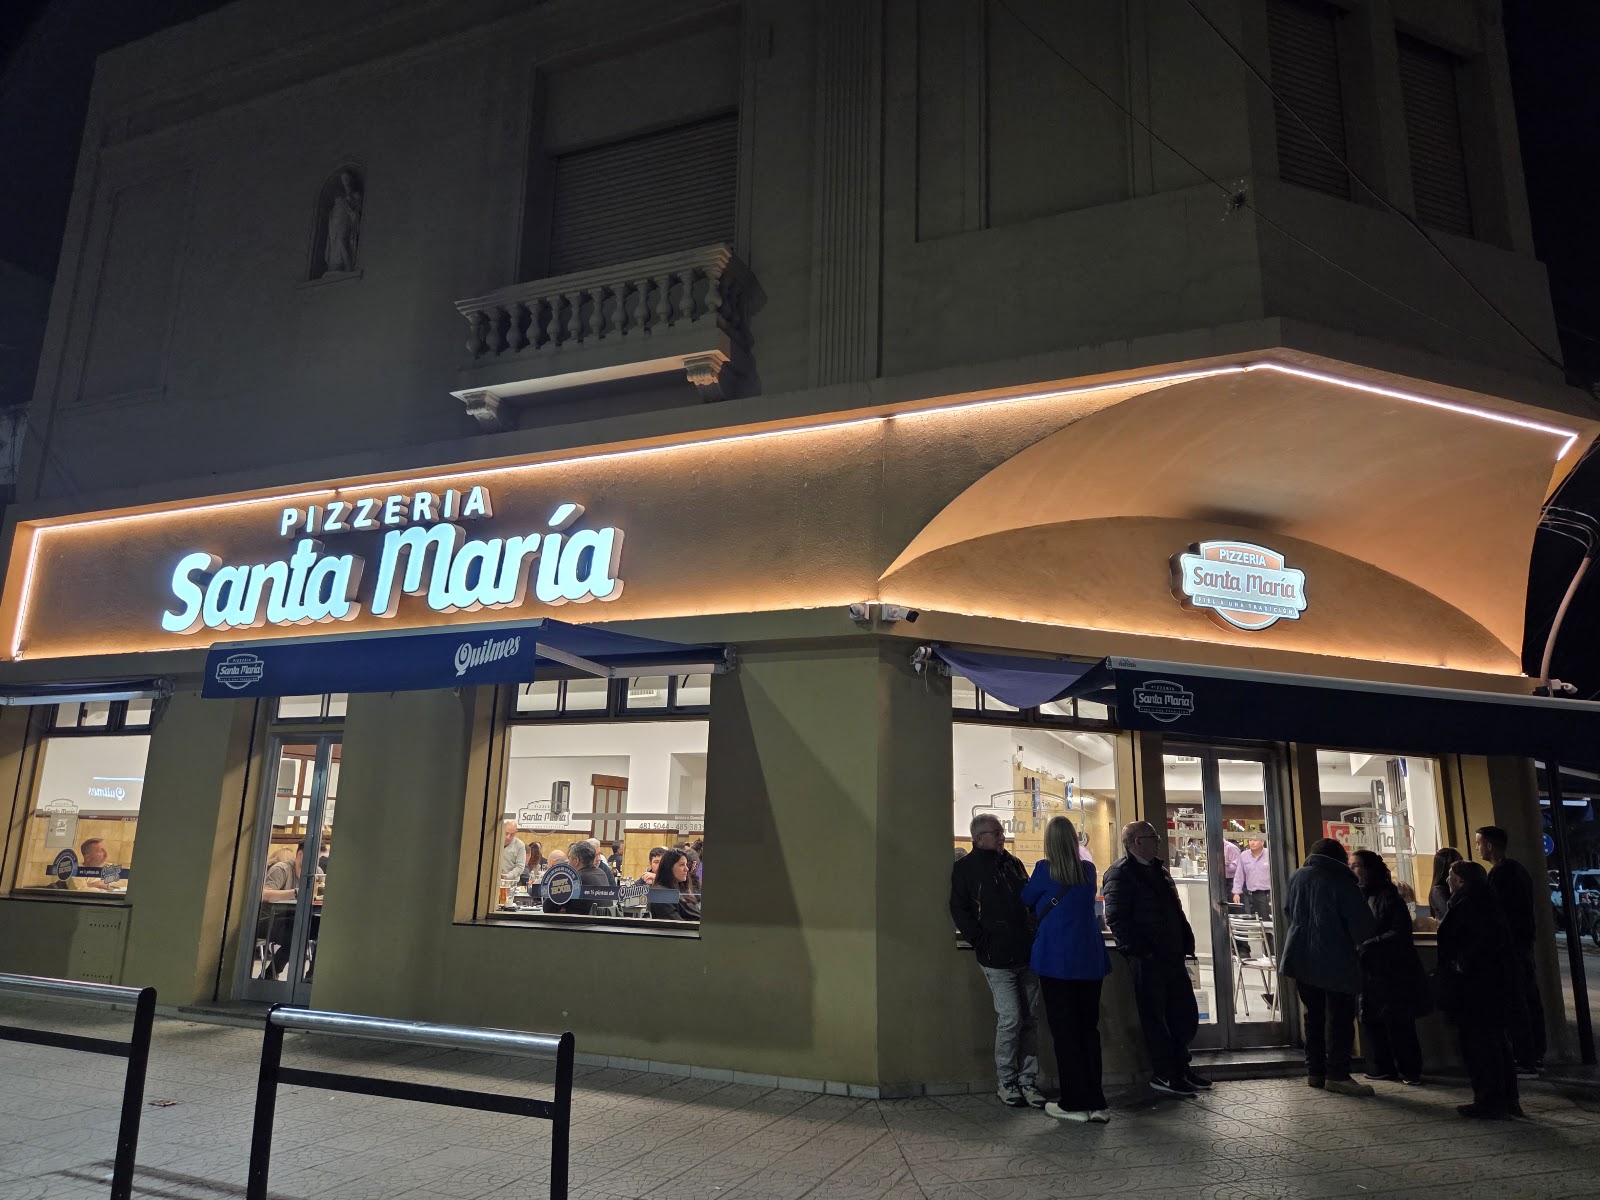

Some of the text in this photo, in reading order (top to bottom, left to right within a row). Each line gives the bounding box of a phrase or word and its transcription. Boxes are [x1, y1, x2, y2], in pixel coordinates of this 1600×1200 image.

[280, 485, 488, 537] PIZZERIA
[1219, 548, 1267, 567] PIZZERIA
[161, 503, 617, 633] Santa María
[1193, 566, 1296, 599] Santa María
[1198, 596, 1216, 605] FIEL
[1228, 601, 1244, 609] UNA
[454, 635, 521, 678] Quilmes
[220, 664, 261, 675] Santa María
[1138, 693, 1190, 707] Santa María
[522, 812, 543, 821] Santa
[639, 822, 651, 830] 481
